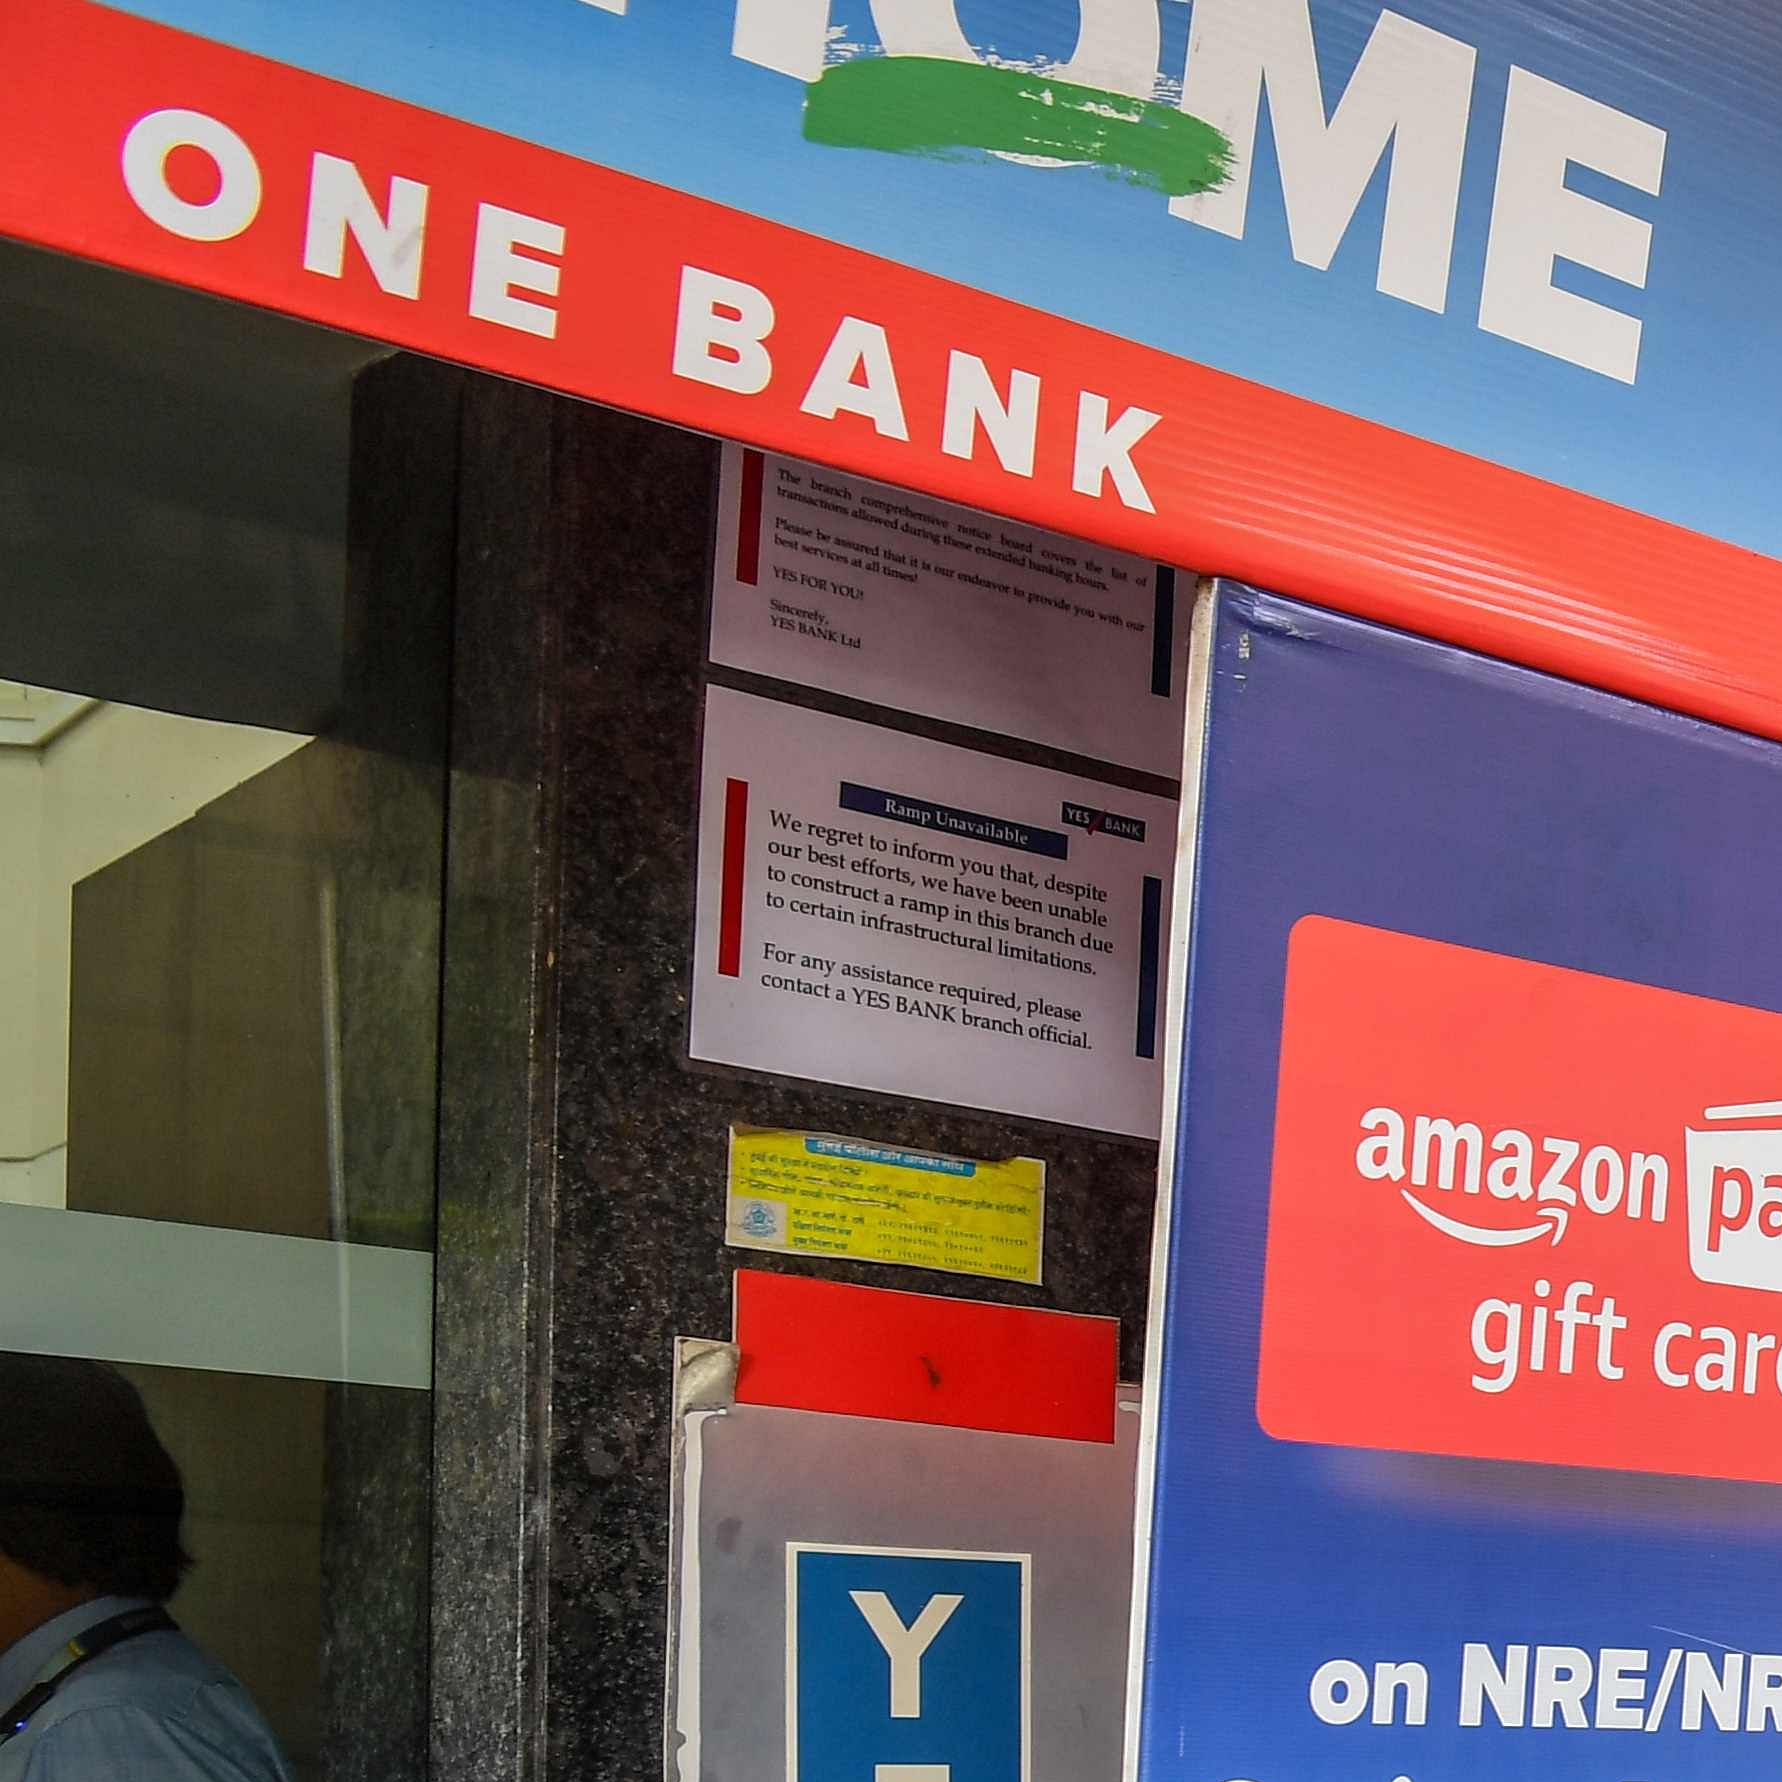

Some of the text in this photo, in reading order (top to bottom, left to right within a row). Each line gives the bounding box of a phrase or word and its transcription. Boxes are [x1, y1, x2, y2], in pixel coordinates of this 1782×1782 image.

[588, 0, 1666, 384] ME
[119, 107, 1166, 516] ONE BANK
[774, 533, 798, 552] best
[801, 543, 848, 565] services
[850, 556, 863, 569] at
[865, 559, 880, 573] all
[777, 486, 848, 515] transactions
[851, 509, 898, 530] allowed
[901, 520, 941, 545] during
[943, 535, 972, 551] these
[975, 545, 1025, 567] extended
[1029, 559, 1073, 584] banking
[778, 468, 1148, 587] The branch comprehensive notice board covers the list of
[770, 598, 829, 625] Sincerely,
[772, 565, 864, 600] YES FOR YOU!
[776, 517, 1145, 632] Please be assured that it is our endeavor to provide you with our
[770, 615, 861, 649] YES BANK Ltd
[770, 809, 1108, 902] We regret to inform you that, despite
[885, 798, 1028, 845] Ramp Unavailable
[1066, 807, 1140, 836] YES BANK
[768, 840, 1108, 927] our best efforts, we have been unable
[768, 865, 1114, 954] to construct a ramp in this branch due
[766, 891, 1097, 976] to certain infrastructural limitations.
[761, 972, 1093, 1050] contact a YES BANK branch official.
[763, 942, 1082, 1023] For any assistance required, please
[1356, 1107, 1667, 1222] amazon
[1471, 1280, 1625, 1393] gift
[1309, 1660, 1427, 1727] on
